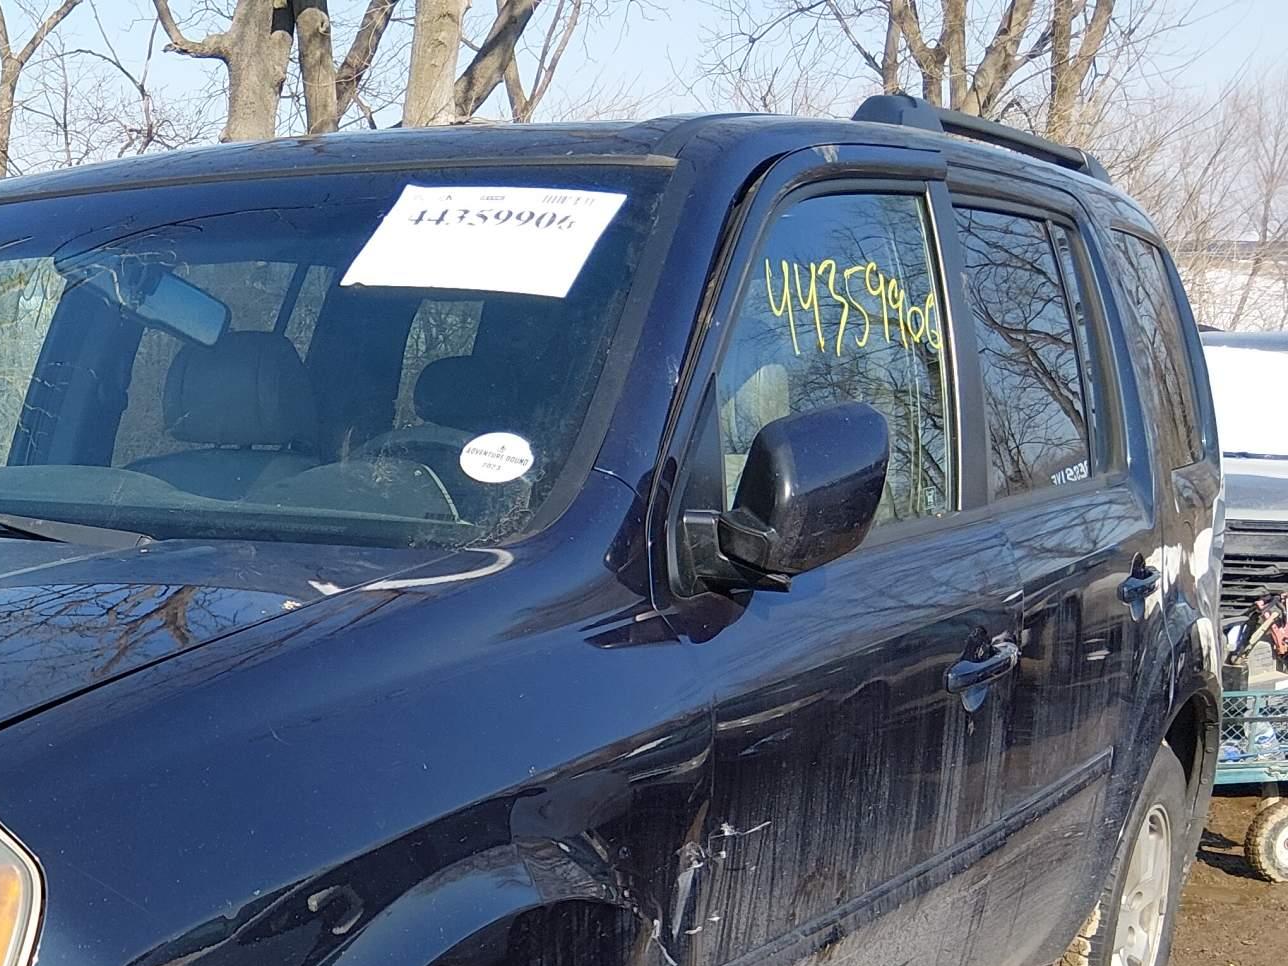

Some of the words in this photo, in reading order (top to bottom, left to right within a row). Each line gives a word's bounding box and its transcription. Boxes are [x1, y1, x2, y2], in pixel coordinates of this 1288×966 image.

[409, 208, 575, 230] 44359906
[765, 258, 942, 356] 44359906
[466, 447, 504, 460] ADVENTURE
[505, 456, 529, 466] BOUND
